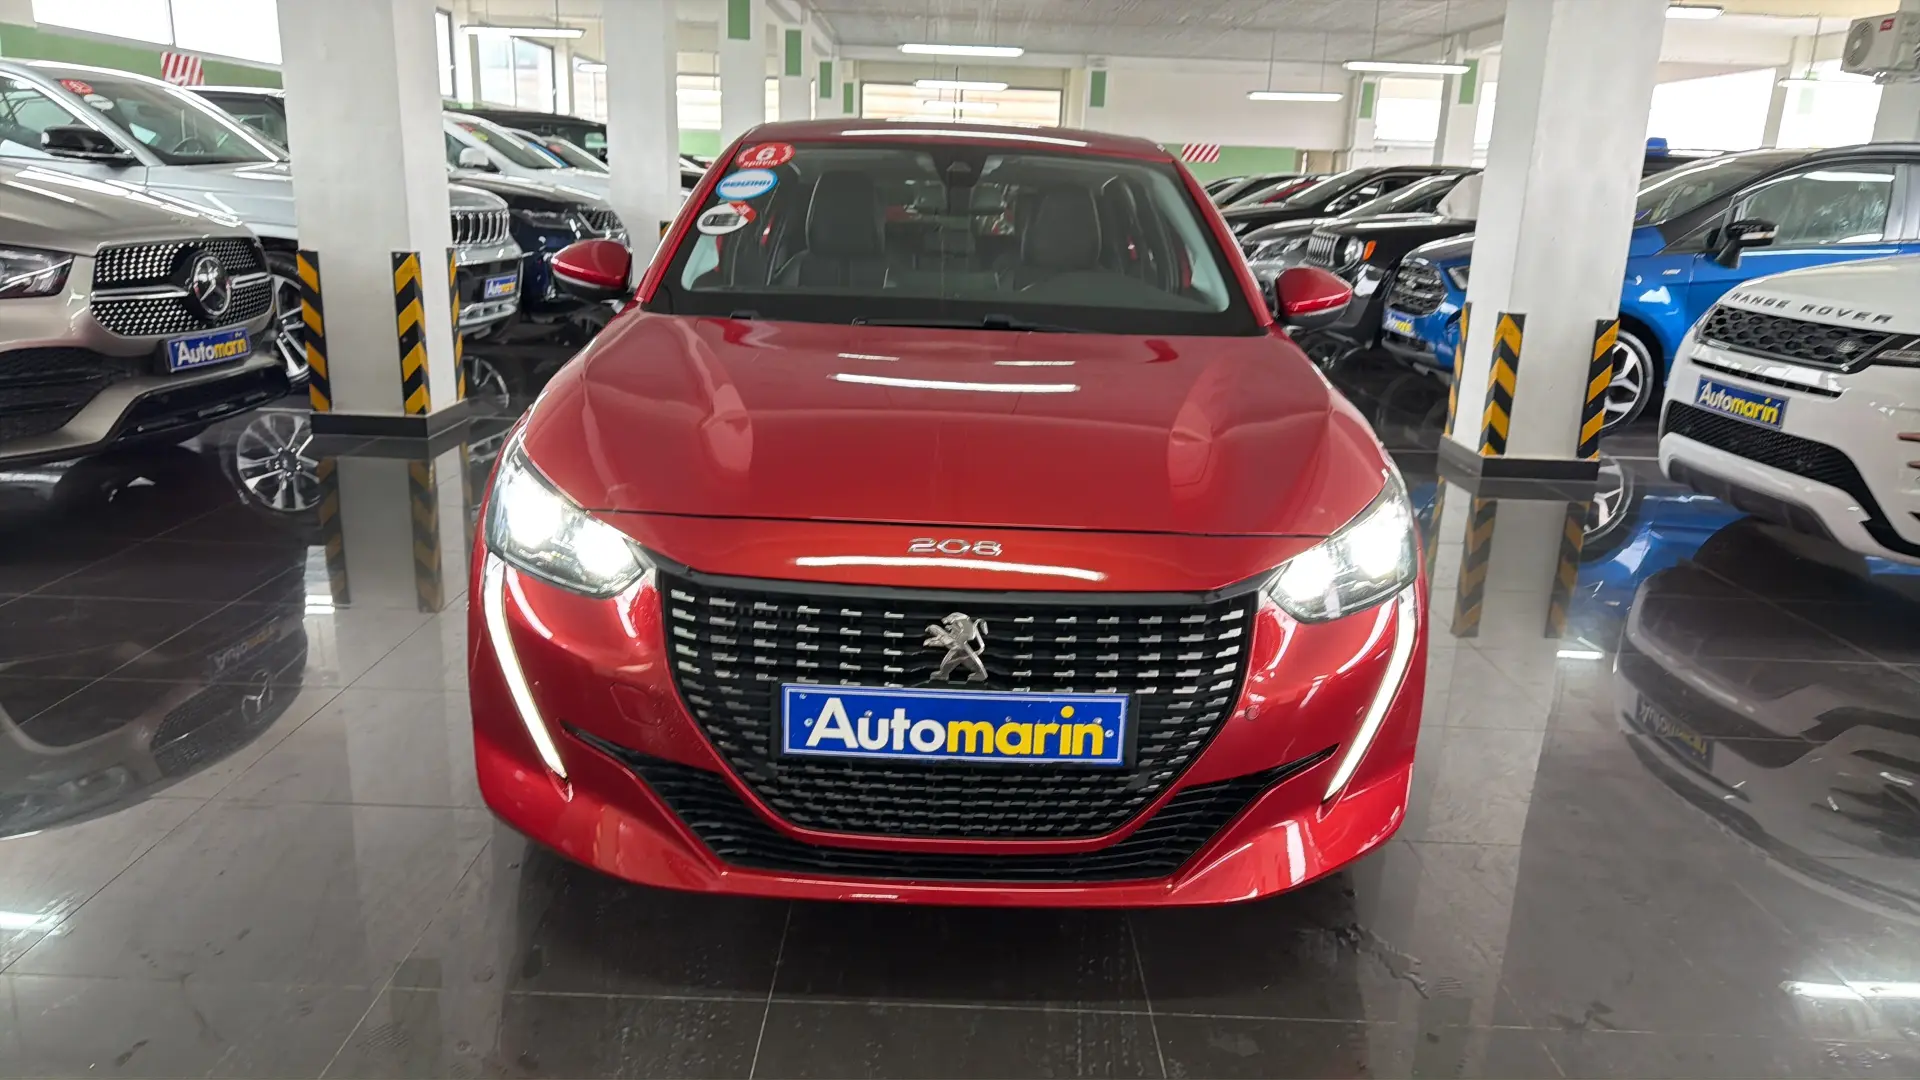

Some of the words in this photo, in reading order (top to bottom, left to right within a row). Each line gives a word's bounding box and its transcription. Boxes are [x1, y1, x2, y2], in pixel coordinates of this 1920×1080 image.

[1730, 292, 1791, 309] RANGE
[1799, 303, 1894, 325] ROVER
[177, 339, 247, 366] Automarin
[1698, 381, 1779, 424] Automarin
[907, 537, 1003, 557] 208
[805, 697, 1105, 756] Automarin
